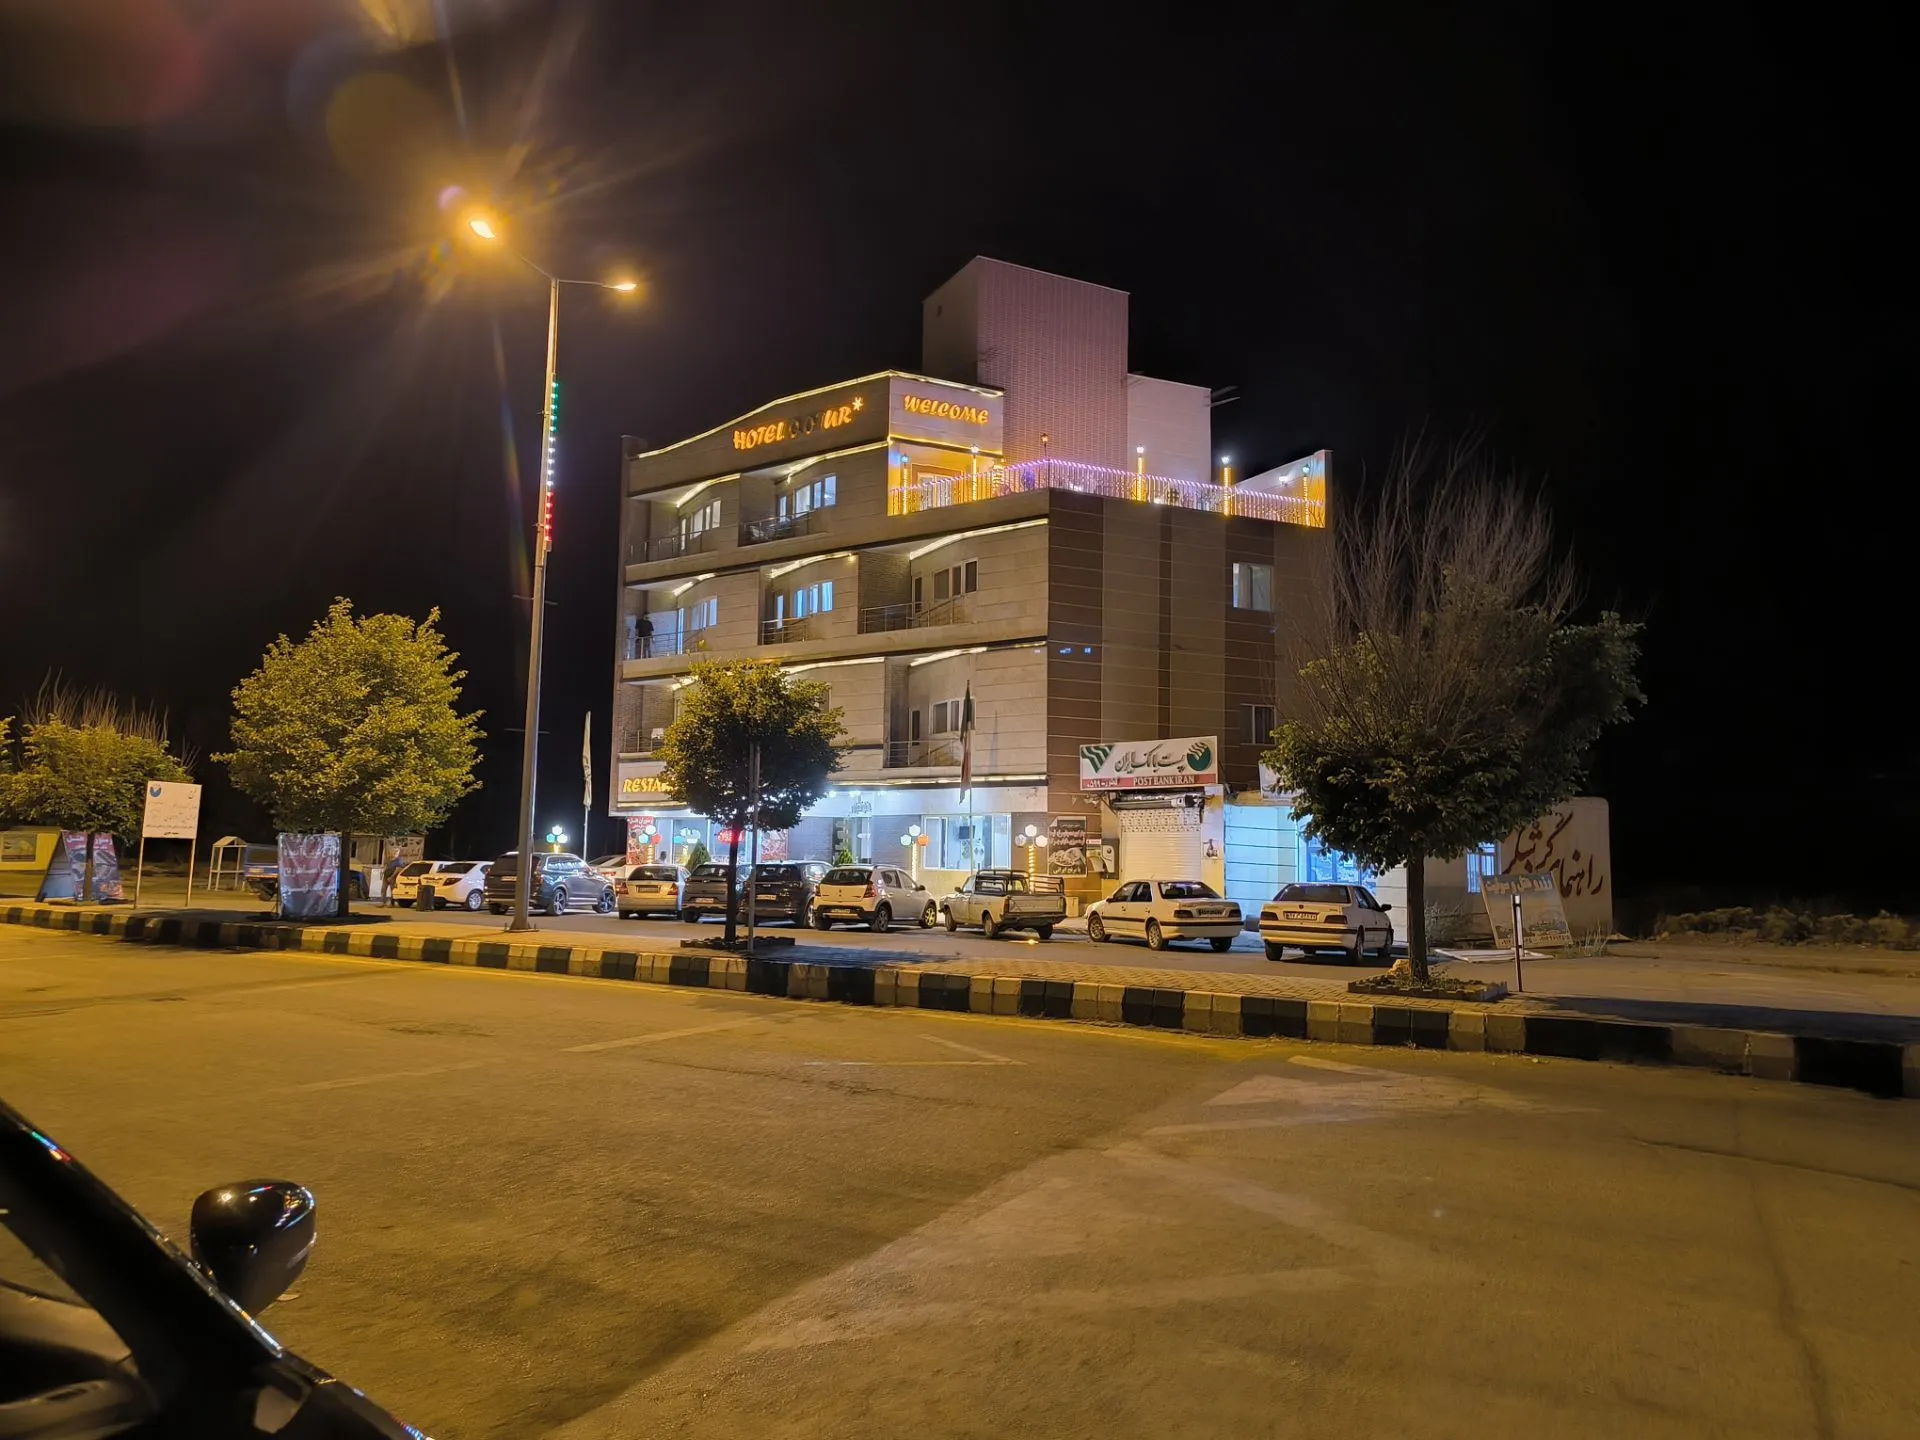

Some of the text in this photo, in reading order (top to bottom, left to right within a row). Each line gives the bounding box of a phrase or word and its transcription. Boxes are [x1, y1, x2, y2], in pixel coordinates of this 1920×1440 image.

[904, 395, 989, 424] WELCOME
[733, 421, 785, 450] HOTEL
[1114, 743, 1186, 774] پست بانک ایران
[622, 777, 674, 793] RESTA
[1133, 775, 1195, 786] POST BANK IRAN
